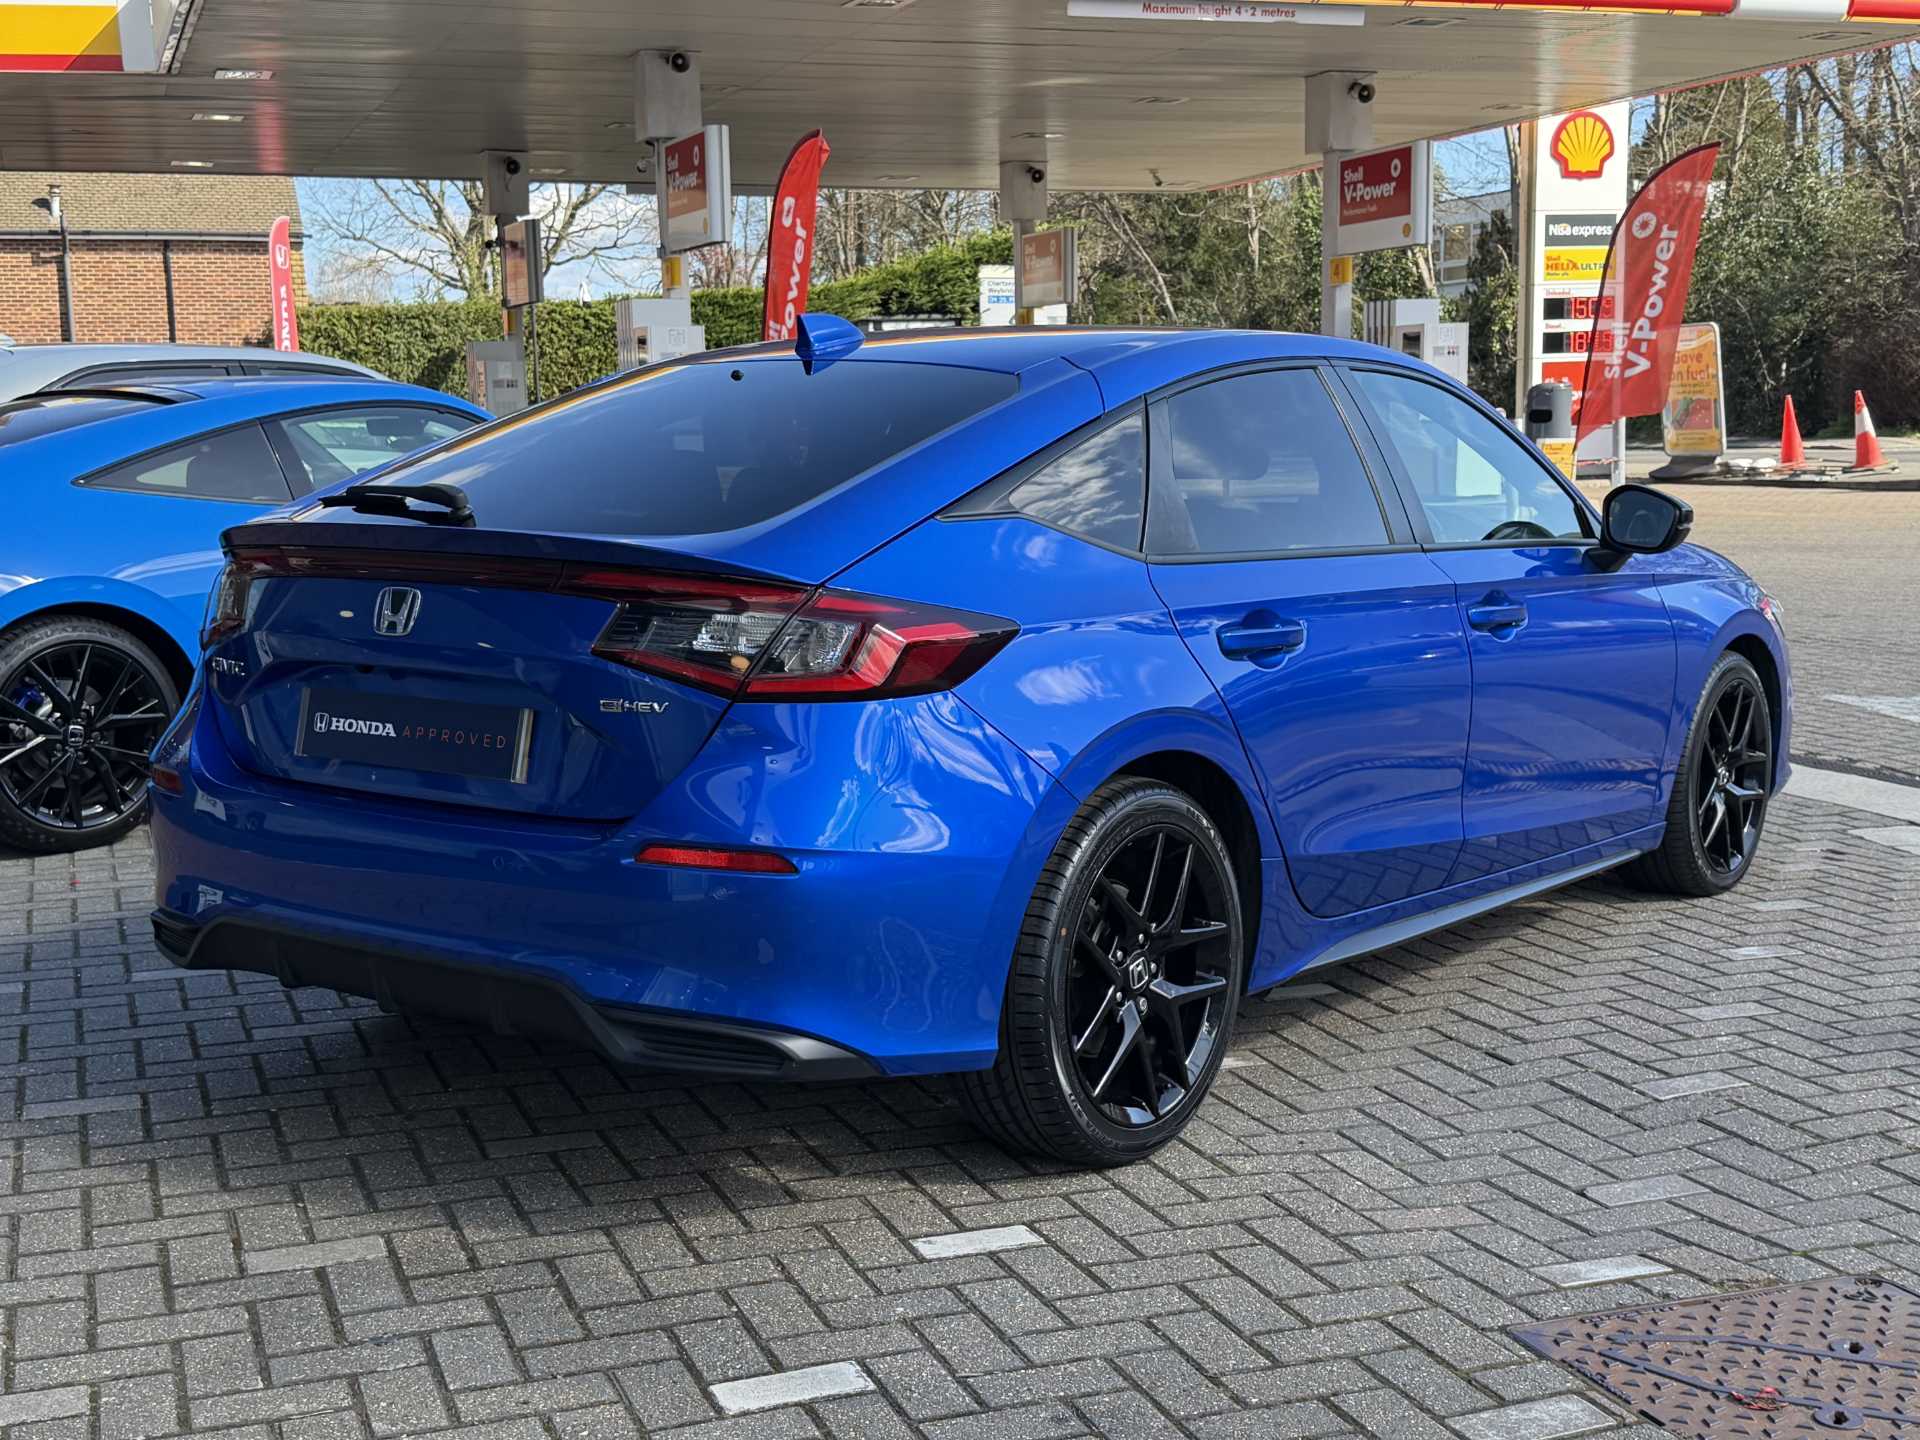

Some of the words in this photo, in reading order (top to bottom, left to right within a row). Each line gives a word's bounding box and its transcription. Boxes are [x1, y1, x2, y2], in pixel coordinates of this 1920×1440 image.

[1142, 3, 1196, 15] Maximum
[1260, 7, 1297, 19] metres
[1343, 165, 1364, 184] Shell
[1343, 181, 1397, 204] V-Power
[1571, 224, 1614, 238] express
[1545, 258, 1580, 271] HELIX
[1624, 223, 1680, 379] V-Power
[1686, 365, 1710, 380] fuel
[329, 716, 397, 738] HONDA
[402, 724, 507, 749] APPROVED
